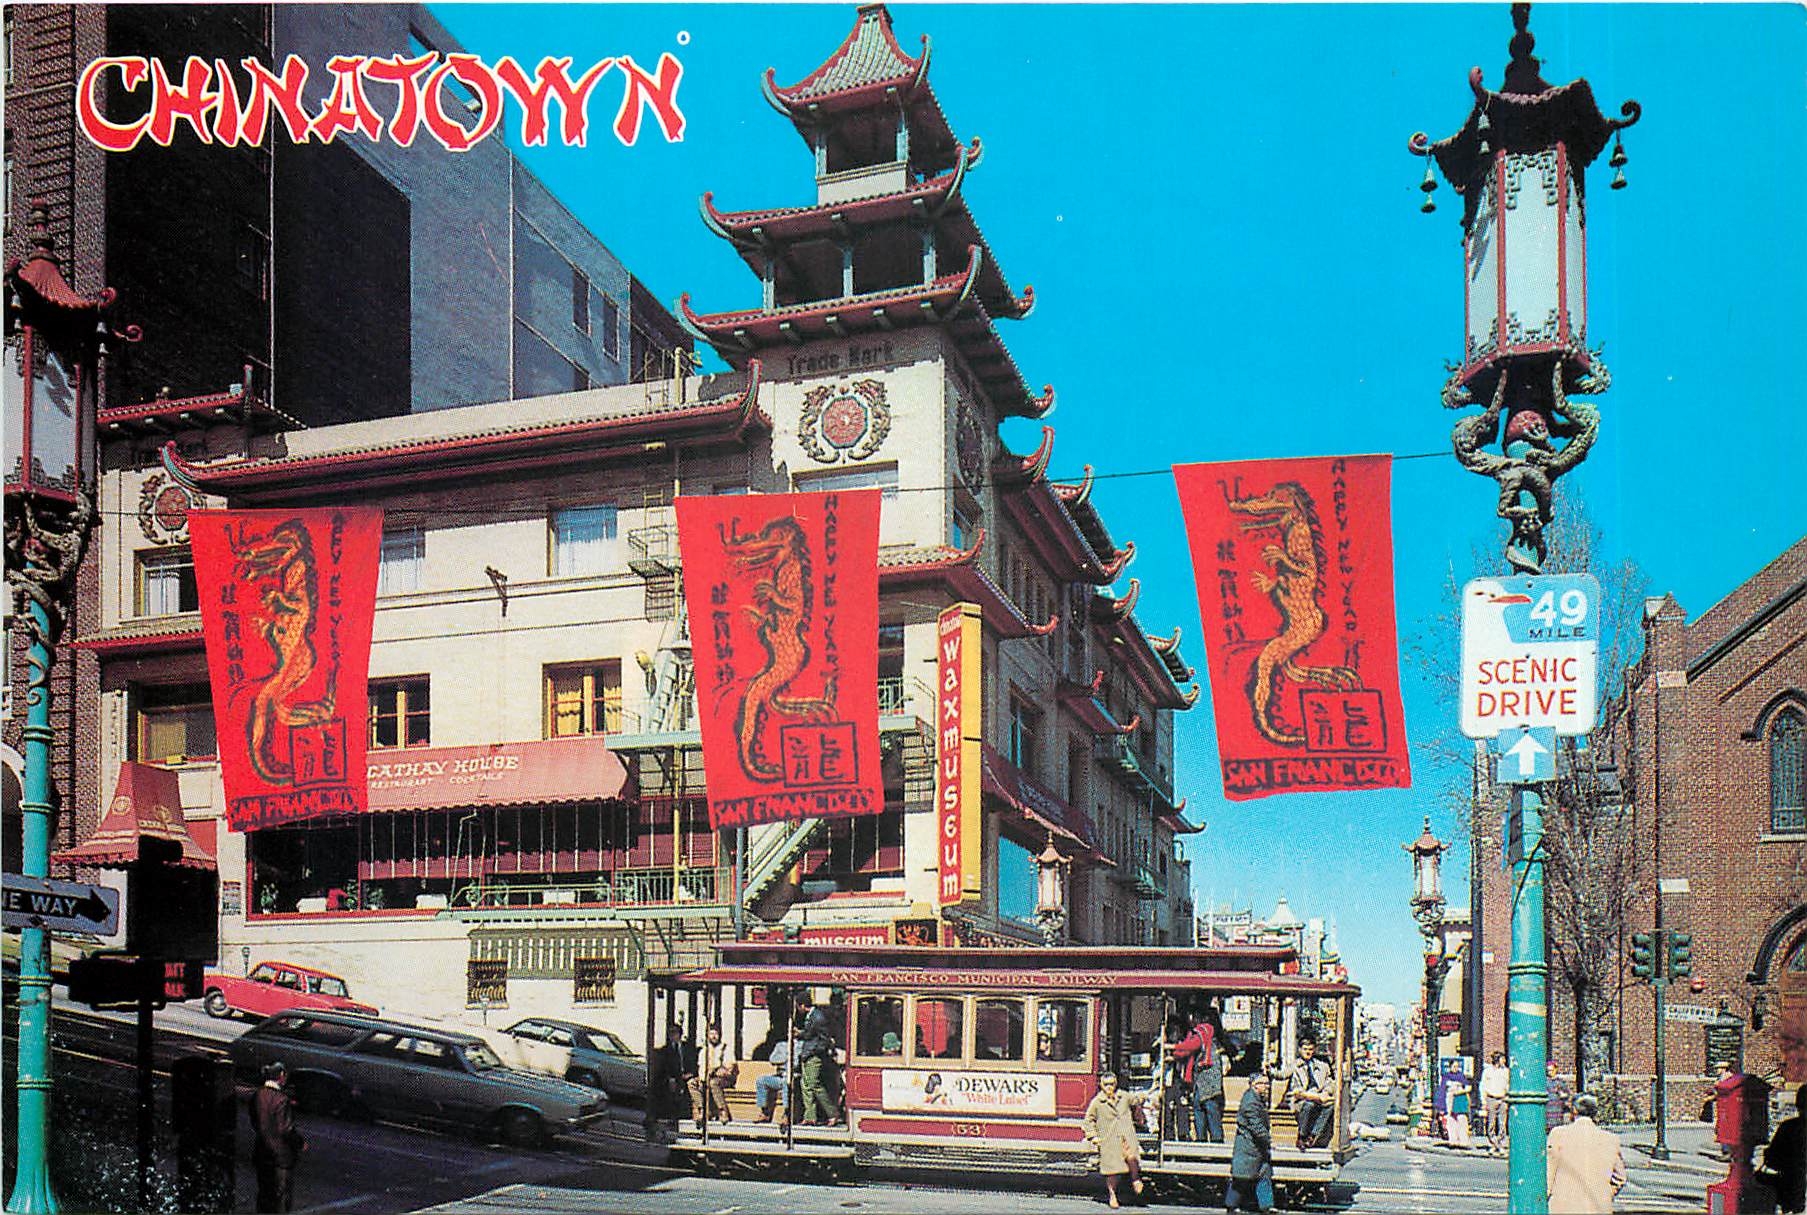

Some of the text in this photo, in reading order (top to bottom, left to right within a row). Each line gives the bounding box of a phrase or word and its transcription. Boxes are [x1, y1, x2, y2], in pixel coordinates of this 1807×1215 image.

[1529, 588, 1588, 628] 49
[1529, 626, 1587, 640] MILE
[1477, 657, 1578, 686] SCENIC
[1476, 689, 1578, 718] DRIVE
[367, 755, 519, 779] CATHAY HOUSE
[943, 635, 961, 898] wax museum
[31, 894, 78, 914] WAY
[831, 972, 1118, 986] SAN FRANCISCO MUNICIPAL RAILWAY
[956, 1076, 1039, 1094] DEWAR'S
